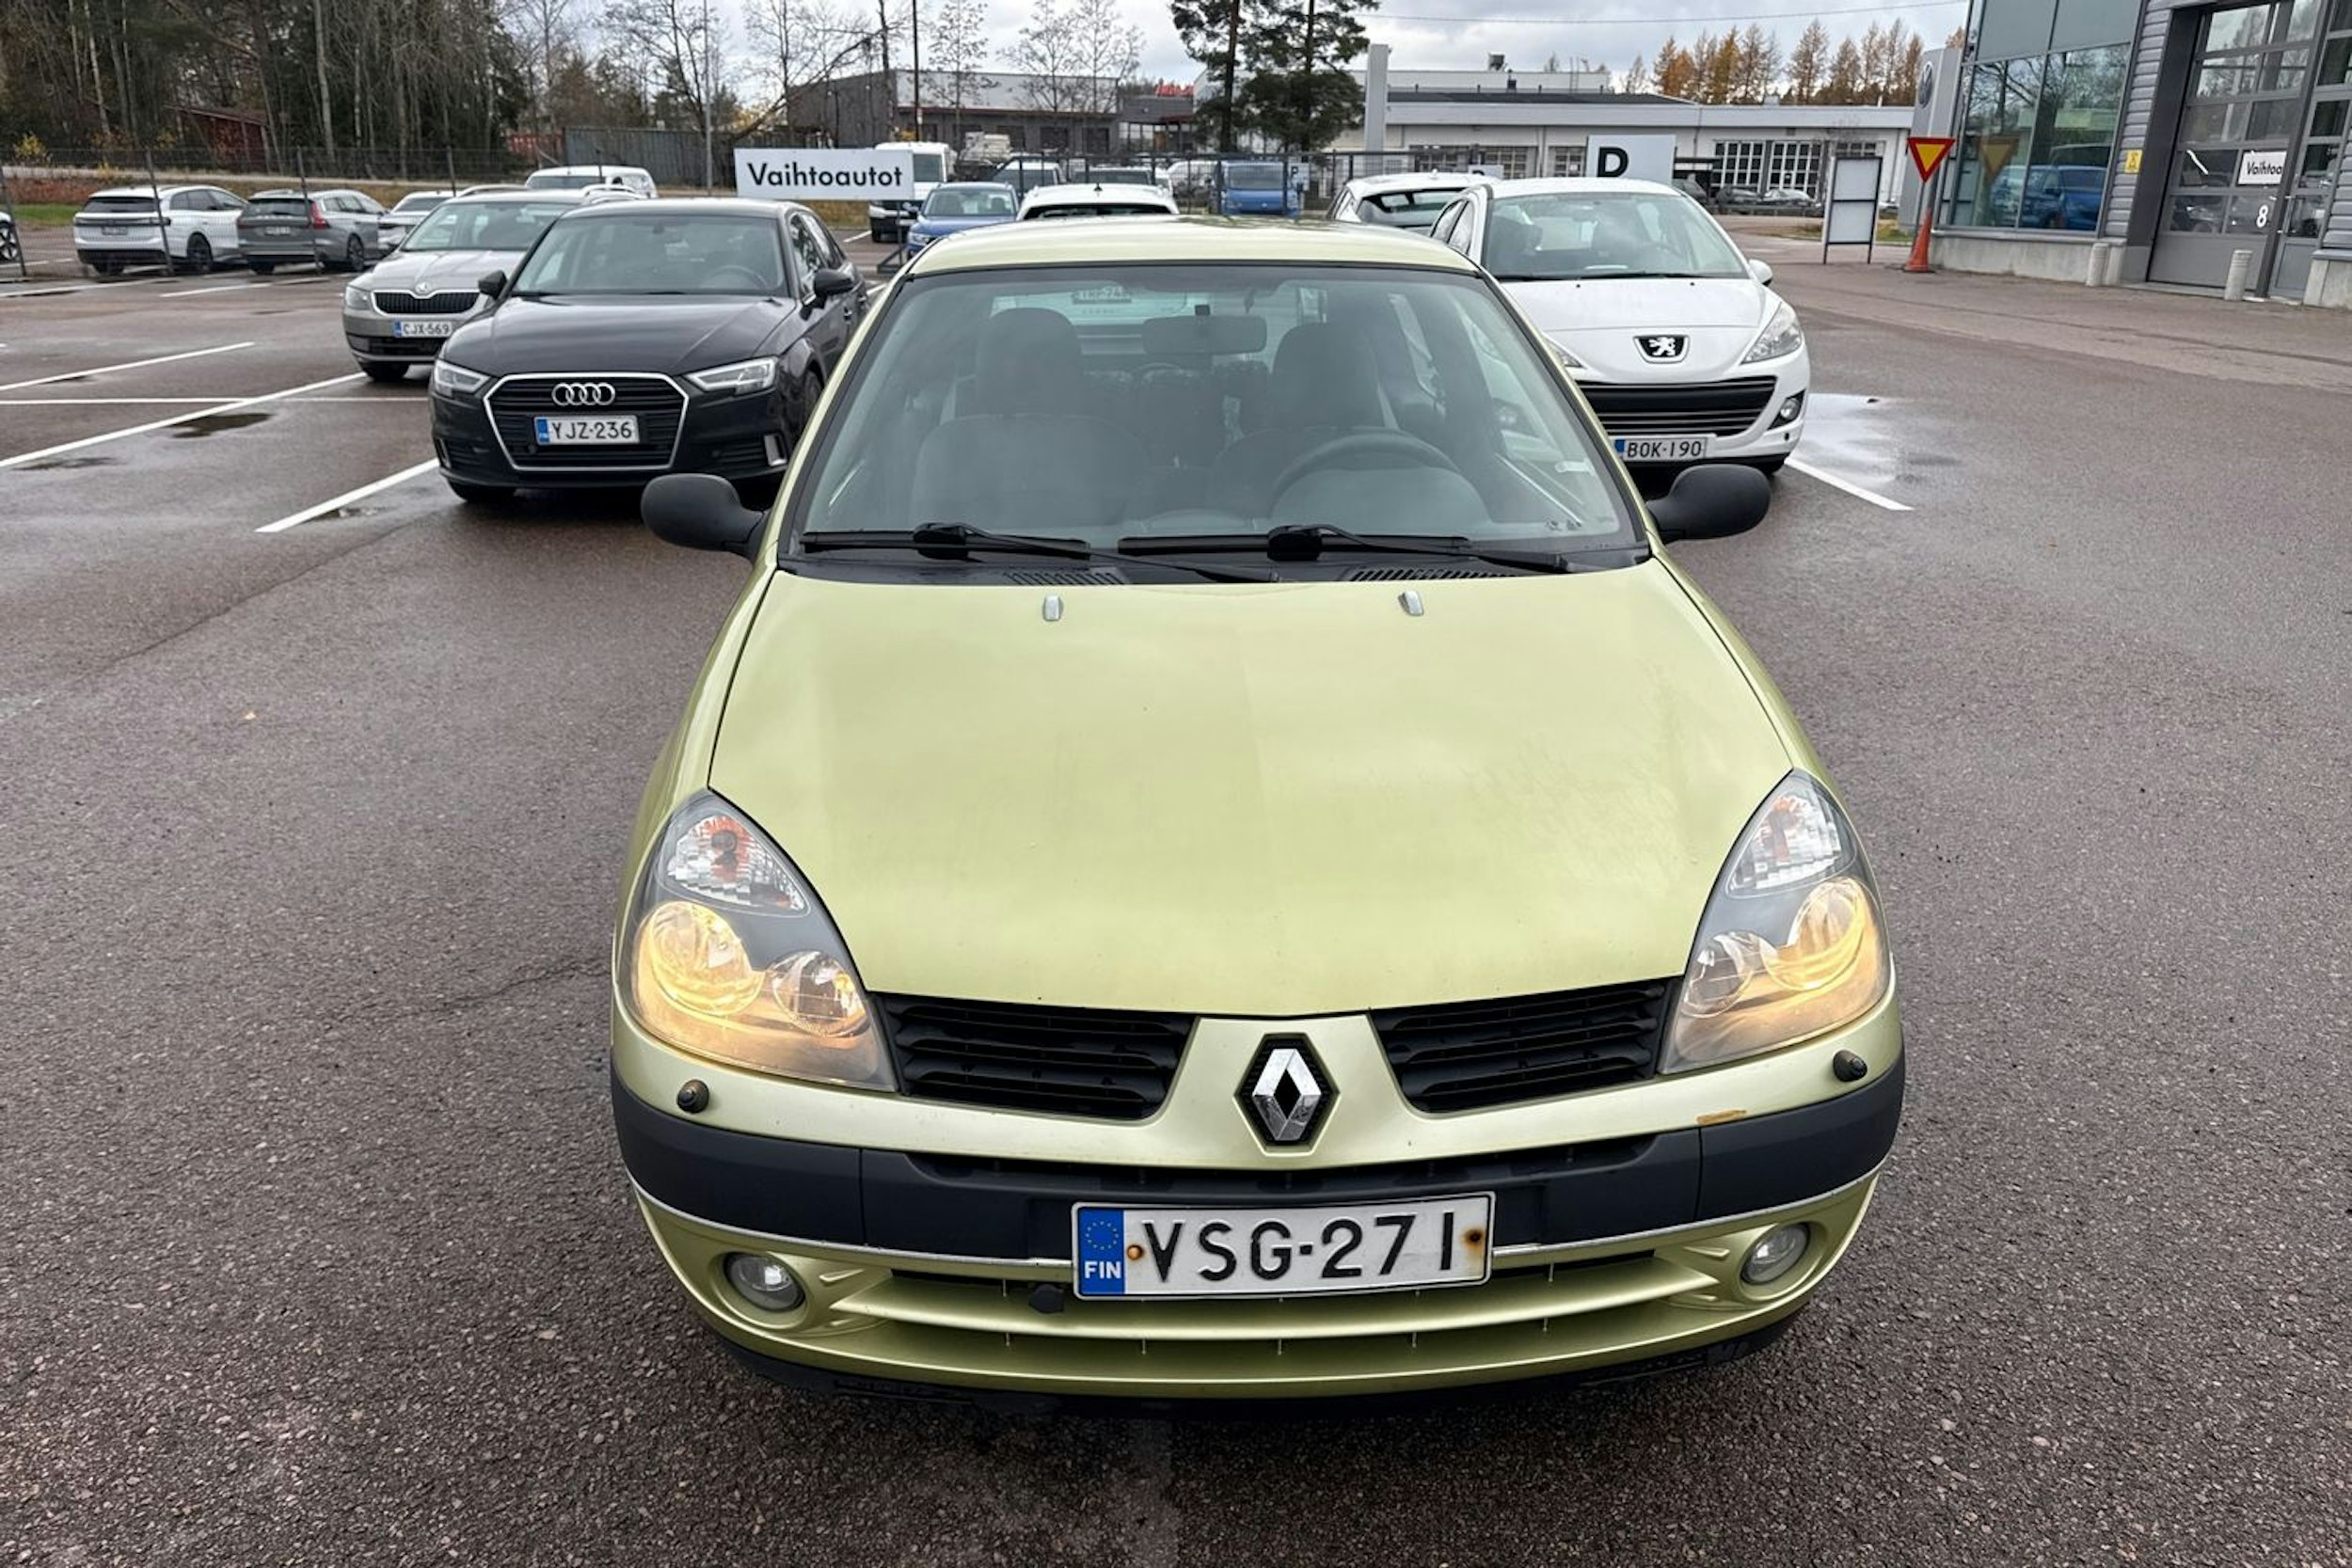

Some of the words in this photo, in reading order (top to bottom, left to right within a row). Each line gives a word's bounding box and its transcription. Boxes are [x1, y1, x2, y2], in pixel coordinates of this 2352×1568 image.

[747, 162, 903, 186] Vaihtoautot
[2256, 204, 2268, 228] 8
[404, 324, 450, 335] CJX-569
[551, 421, 632, 439] YJZ-236
[1628, 441, 1702, 458] BOK-190
[1142, 1212, 1454, 1283] VSG-271
[1084, 1260, 1121, 1279] FIN
